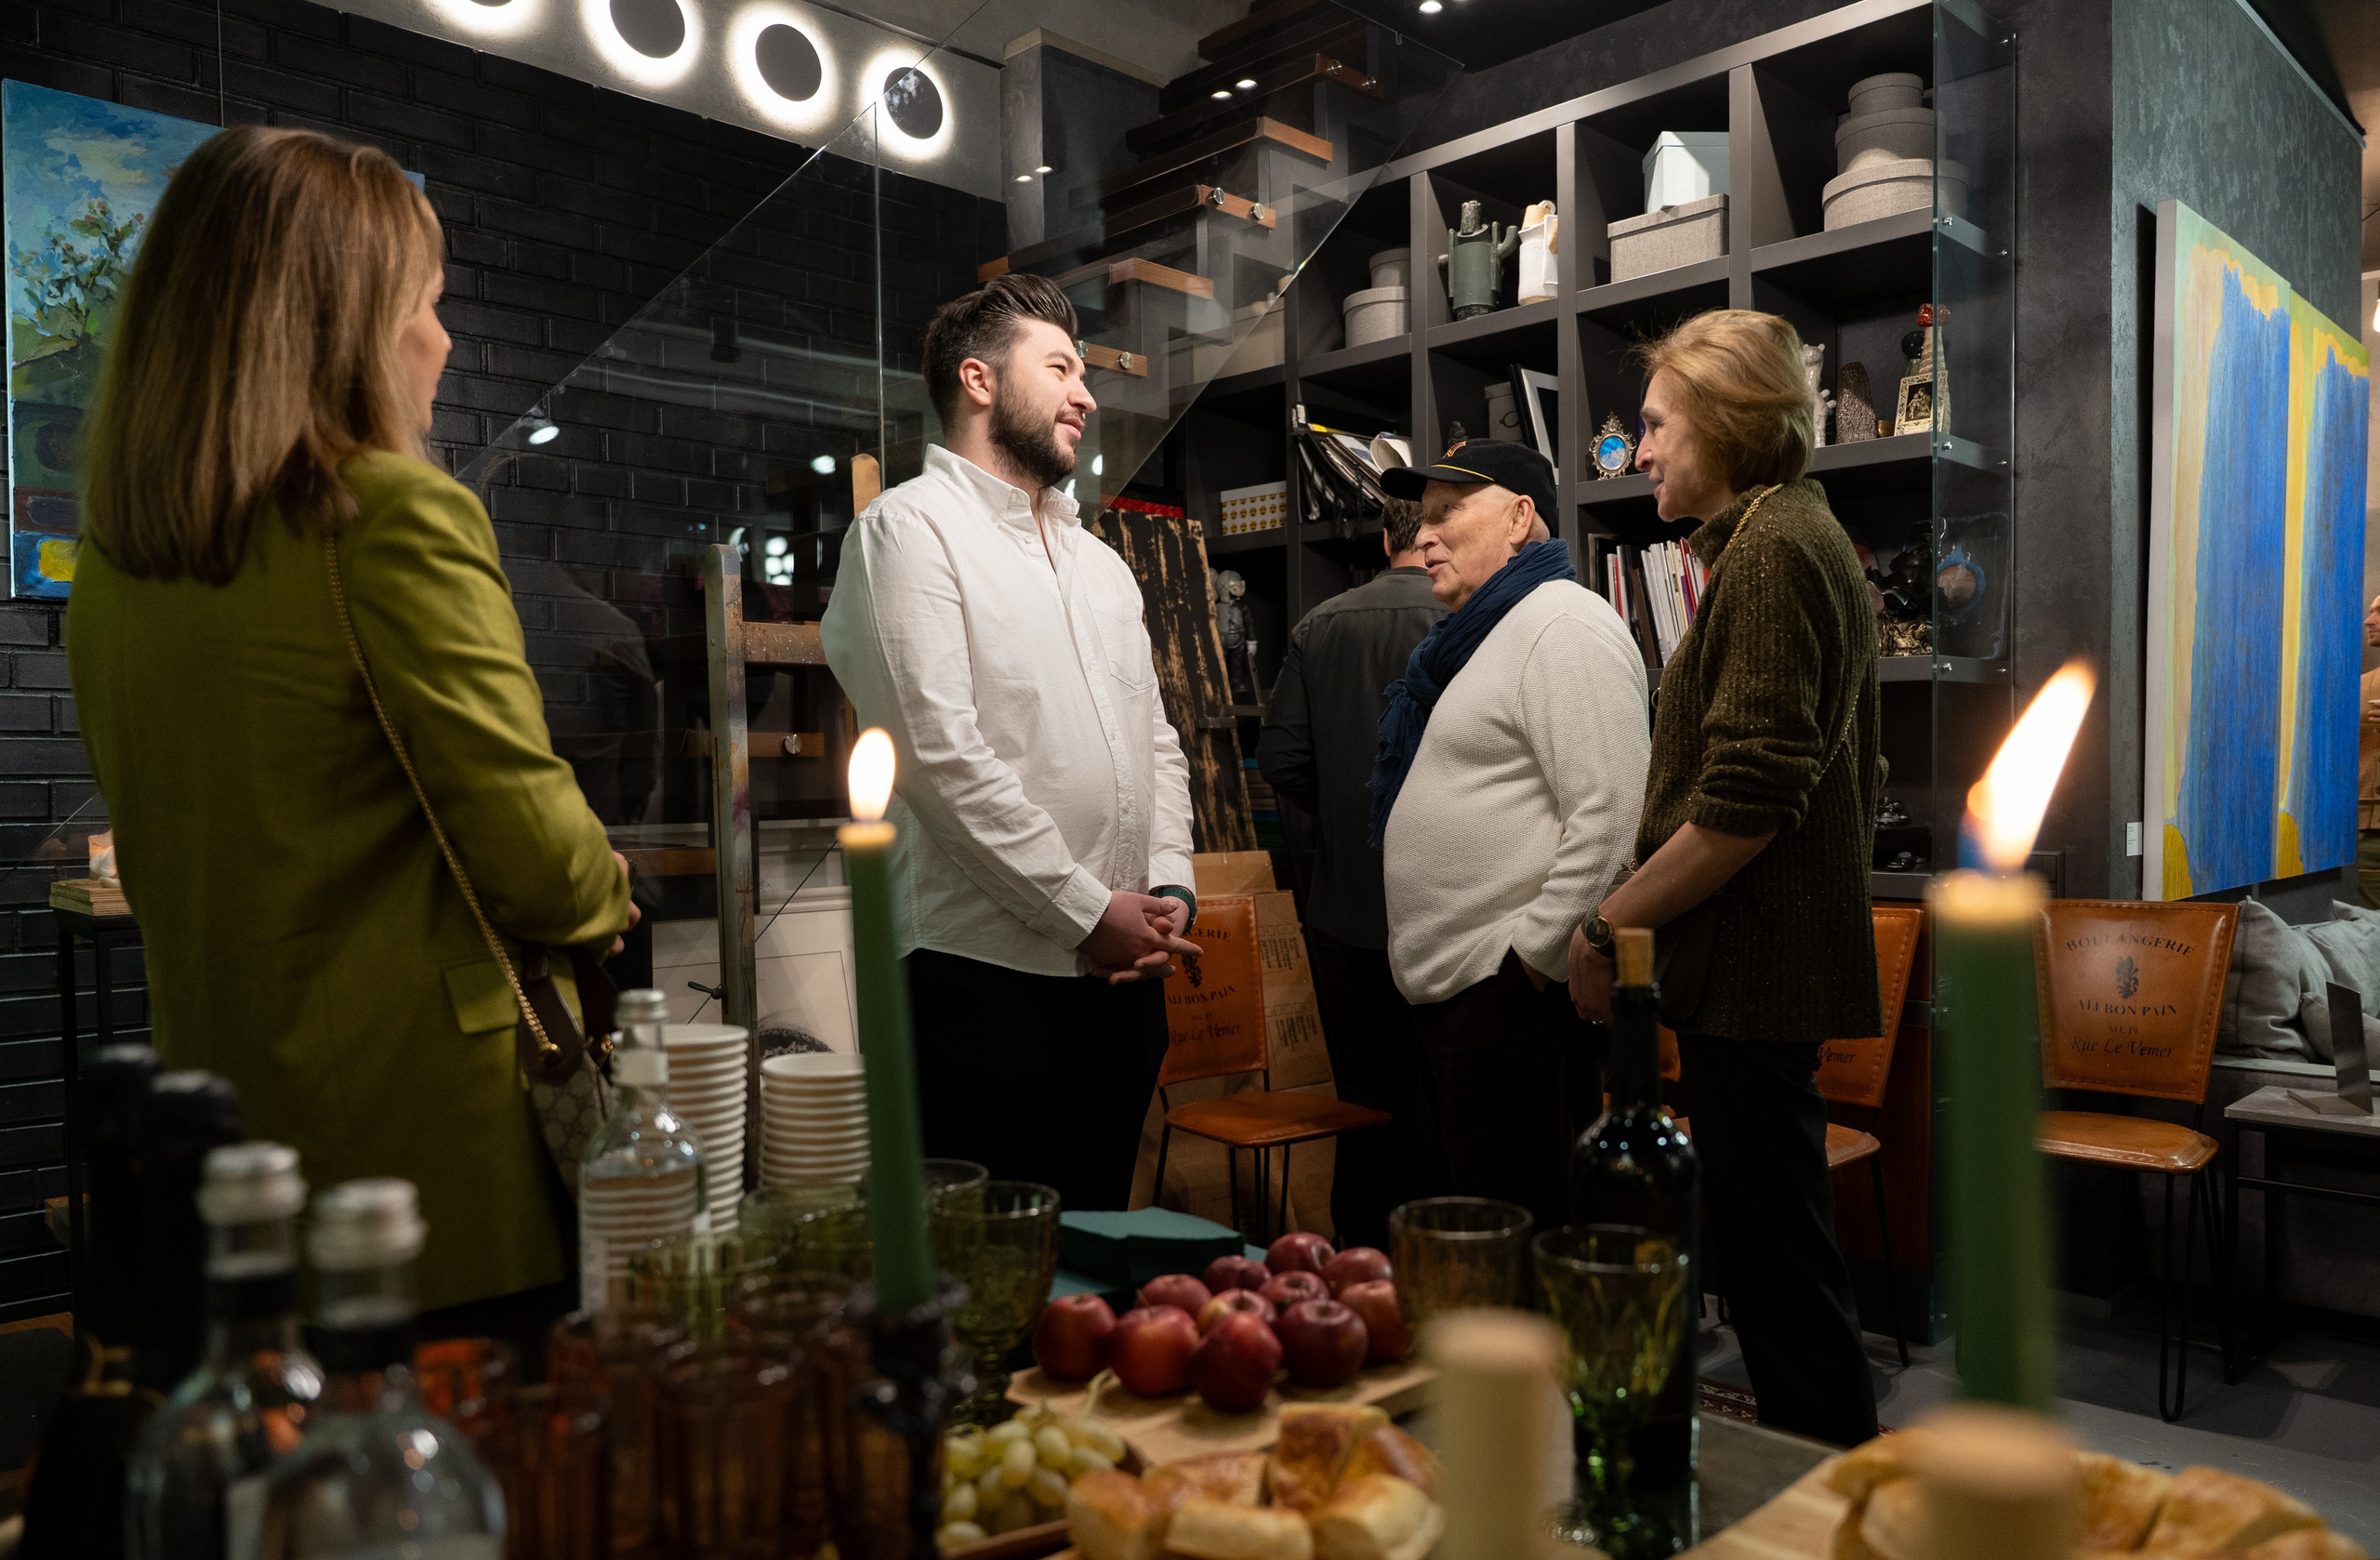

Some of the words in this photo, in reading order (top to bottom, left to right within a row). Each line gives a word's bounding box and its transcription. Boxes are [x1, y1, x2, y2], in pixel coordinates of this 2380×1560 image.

[2066, 933, 2195, 958] BOULANGERIE
[1210, 985, 1236, 1001] PAIN
[2105, 1003, 2137, 1016] BON
[2142, 1004, 2177, 1016] PAIN
[2070, 1036, 2099, 1053] Rue
[2104, 1038, 2123, 1054] Le
